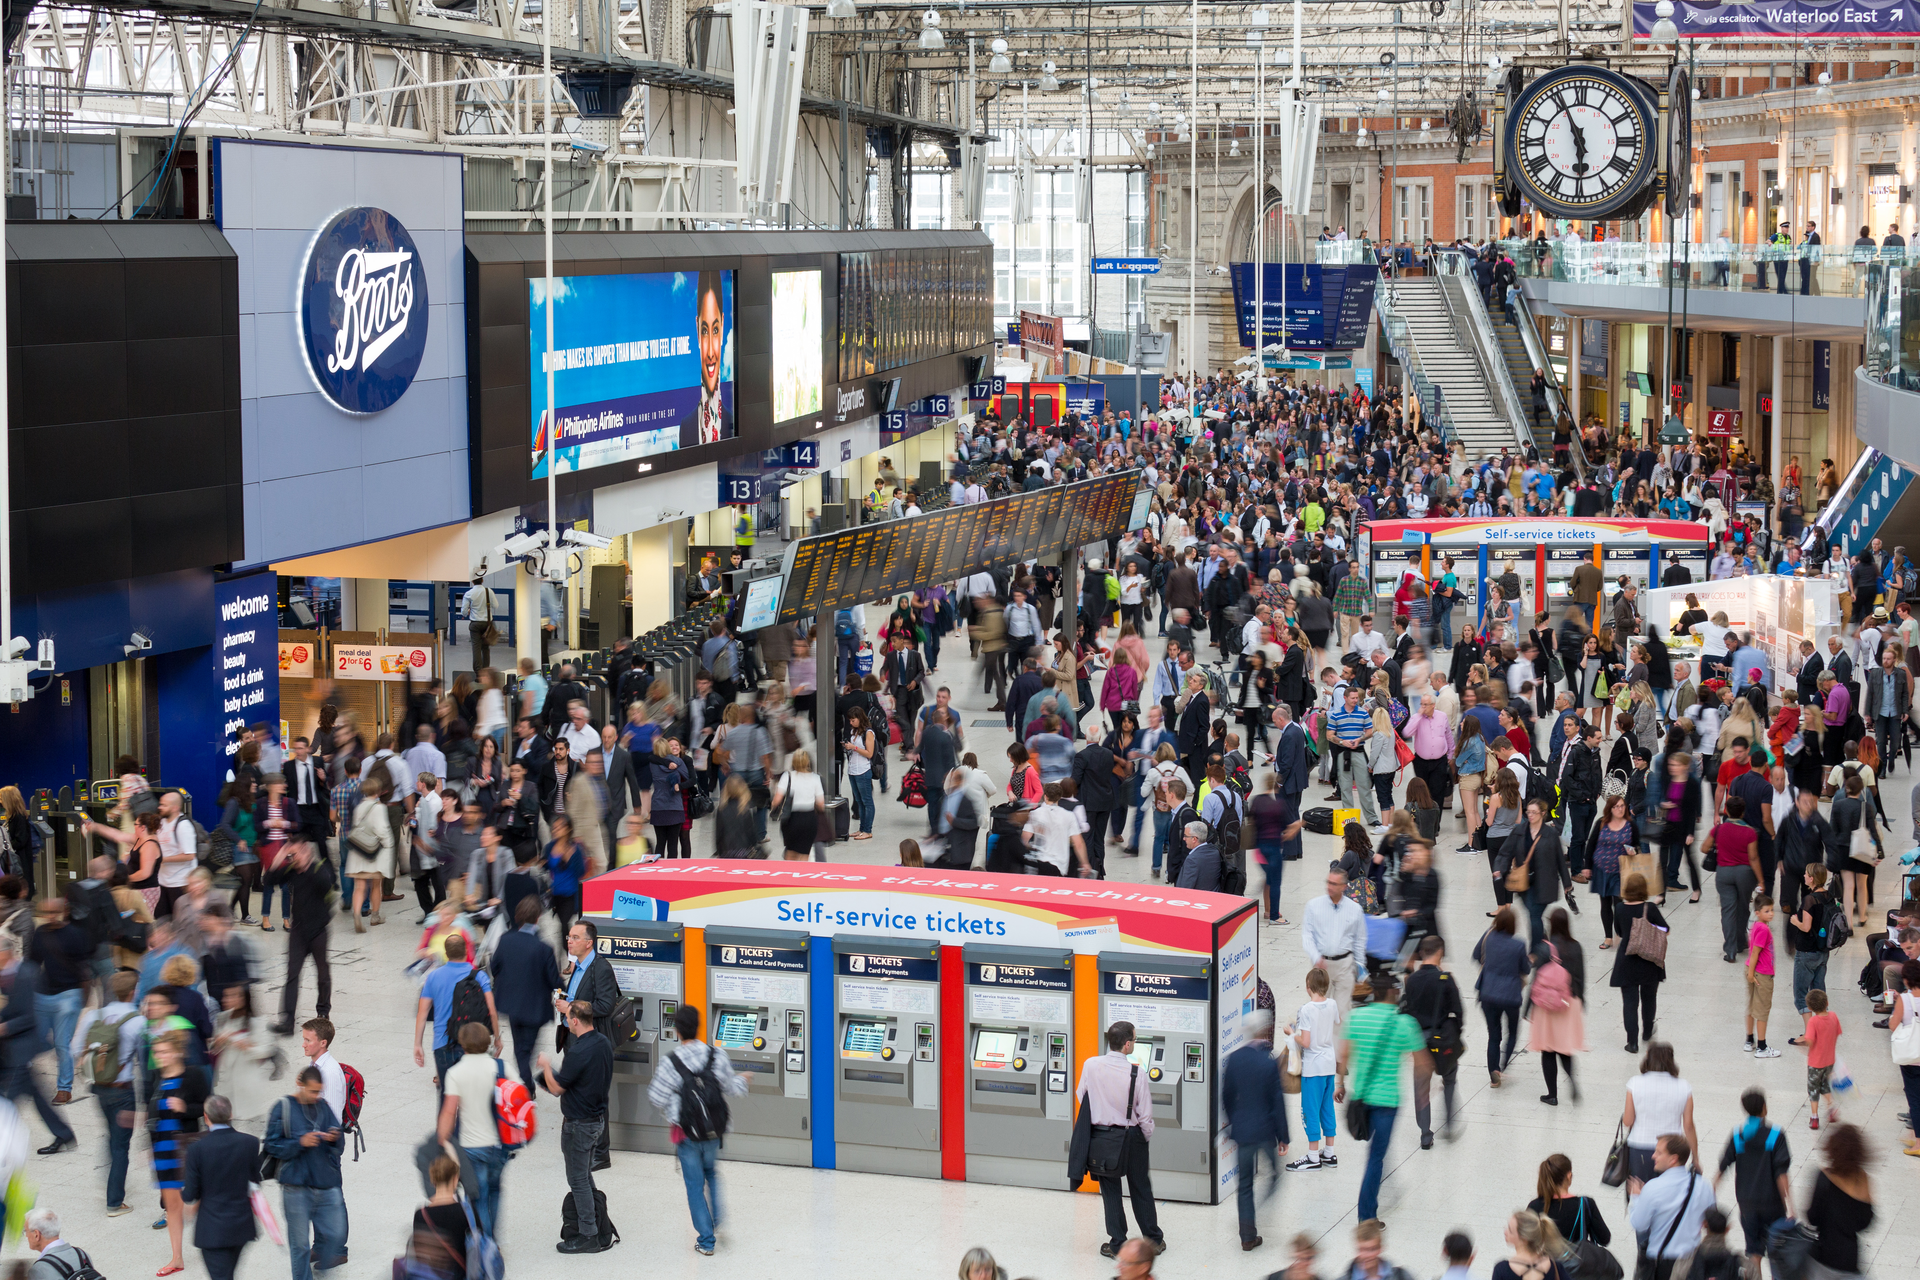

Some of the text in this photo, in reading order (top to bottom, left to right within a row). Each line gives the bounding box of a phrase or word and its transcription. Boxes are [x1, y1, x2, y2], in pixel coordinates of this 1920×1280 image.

[1704, 8, 1878, 24] via escalator Waterloo East
[328, 246, 413, 373] Boots
[542, 336, 691, 372] NHING MAKES US HAPPIER THAN MAKING YOU FEEL AT HOME.
[974, 385, 988, 397] 17
[838, 386, 864, 418] Departures
[930, 399, 946, 412] 16
[564, 410, 624, 439] Philippine Airlines
[626, 408, 676, 424] YOUR HOME IN THE SKY
[886, 414, 902, 429] 15
[792, 446, 812, 464] 14
[730, 480, 750, 499] 13
[1485, 528, 1596, 539] Self-service tickets
[222, 594, 269, 622] welcome
[223, 629, 255, 651] pharmacy
[224, 652, 246, 670] beauty
[339, 658, 346, 670] 2
[359, 658, 372, 670] £6
[224, 668, 264, 691] food & drink
[224, 688, 264, 713] baby & child
[225, 718, 244, 737] photo
[630, 866, 1212, 910] Self-service ticket machines
[618, 895, 645, 907] oyster
[777, 900, 1006, 936] Self-service tickets
[614, 939, 647, 949] TICKETS
[740, 948, 773, 958] TICKETS
[868, 957, 902, 966] TICKETS
[1222, 945, 1251, 973] Self-service
[883, 968, 908, 976] Payments
[999, 966, 1035, 976] TICKETS
[1135, 975, 1171, 985] TICKETS
[1222, 974, 1239, 992] tickets
[1222, 1007, 1238, 1024] Travelcards
[1222, 1027, 1232, 1040] Oyster
[1222, 1034, 1243, 1054] Season tickets
